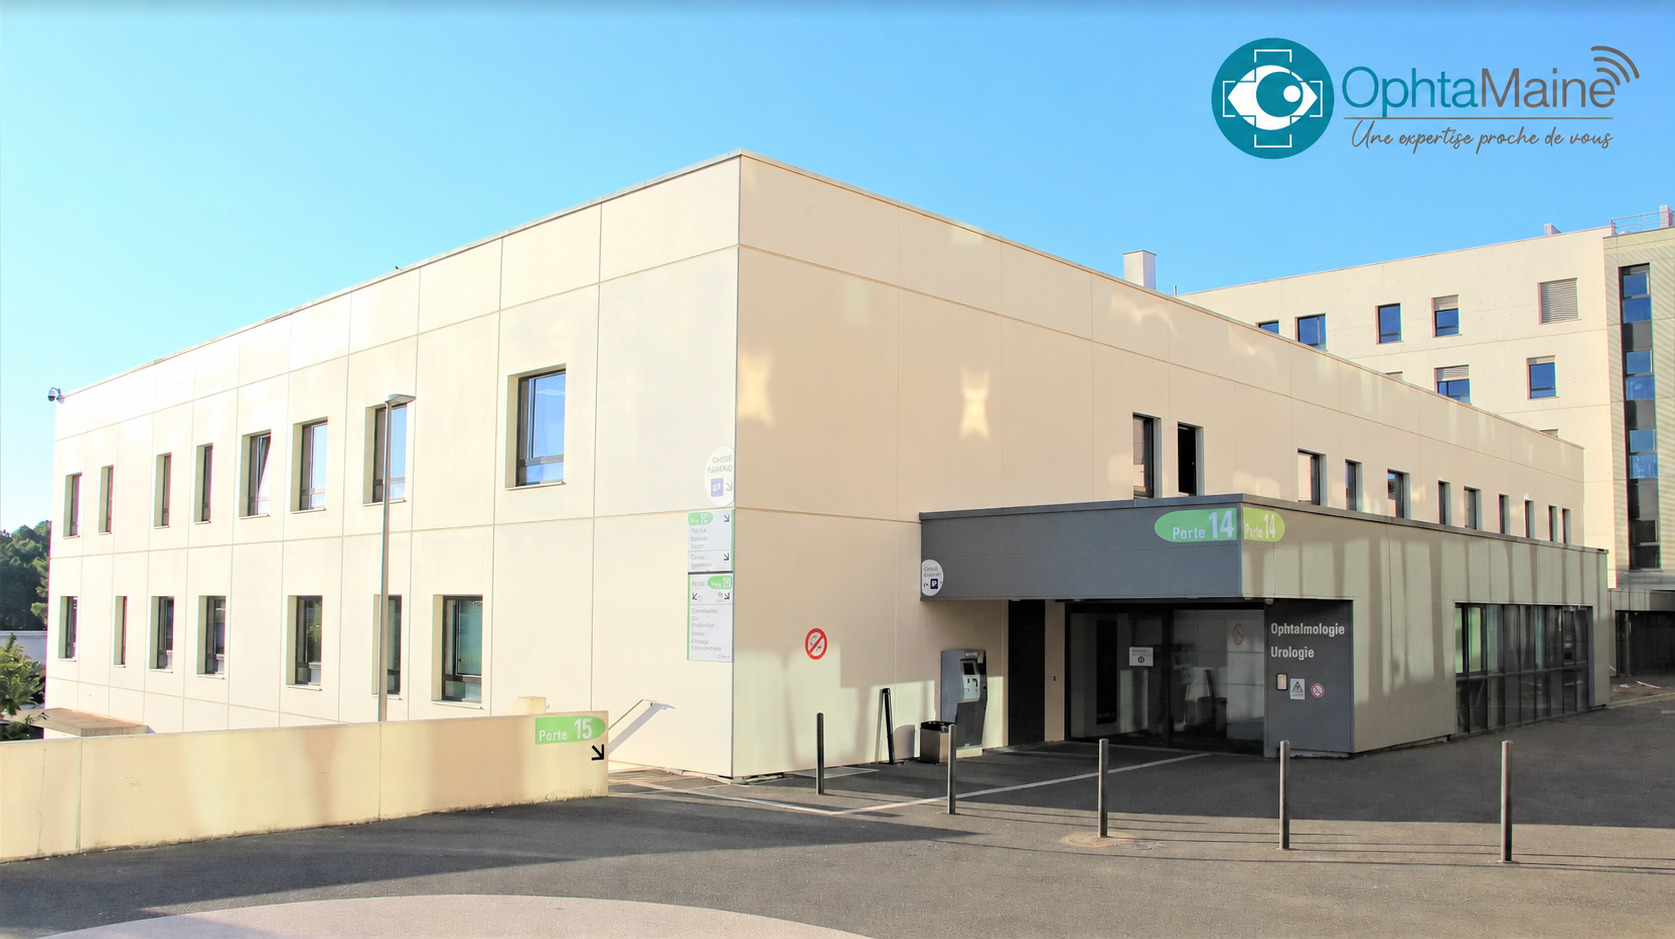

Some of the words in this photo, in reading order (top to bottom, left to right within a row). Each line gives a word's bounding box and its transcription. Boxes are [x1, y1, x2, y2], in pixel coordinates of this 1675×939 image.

[1172, 526, 1206, 540] Porte
[1208, 510, 1235, 539] 14
[1244, 523, 1263, 539] Porte
[1263, 513, 1276, 539] 14
[1270, 622, 1345, 638] Ophtalmologie
[1270, 646, 1315, 661] Urologie
[538, 729, 568, 742] Porte
[574, 717, 592, 740] 15
